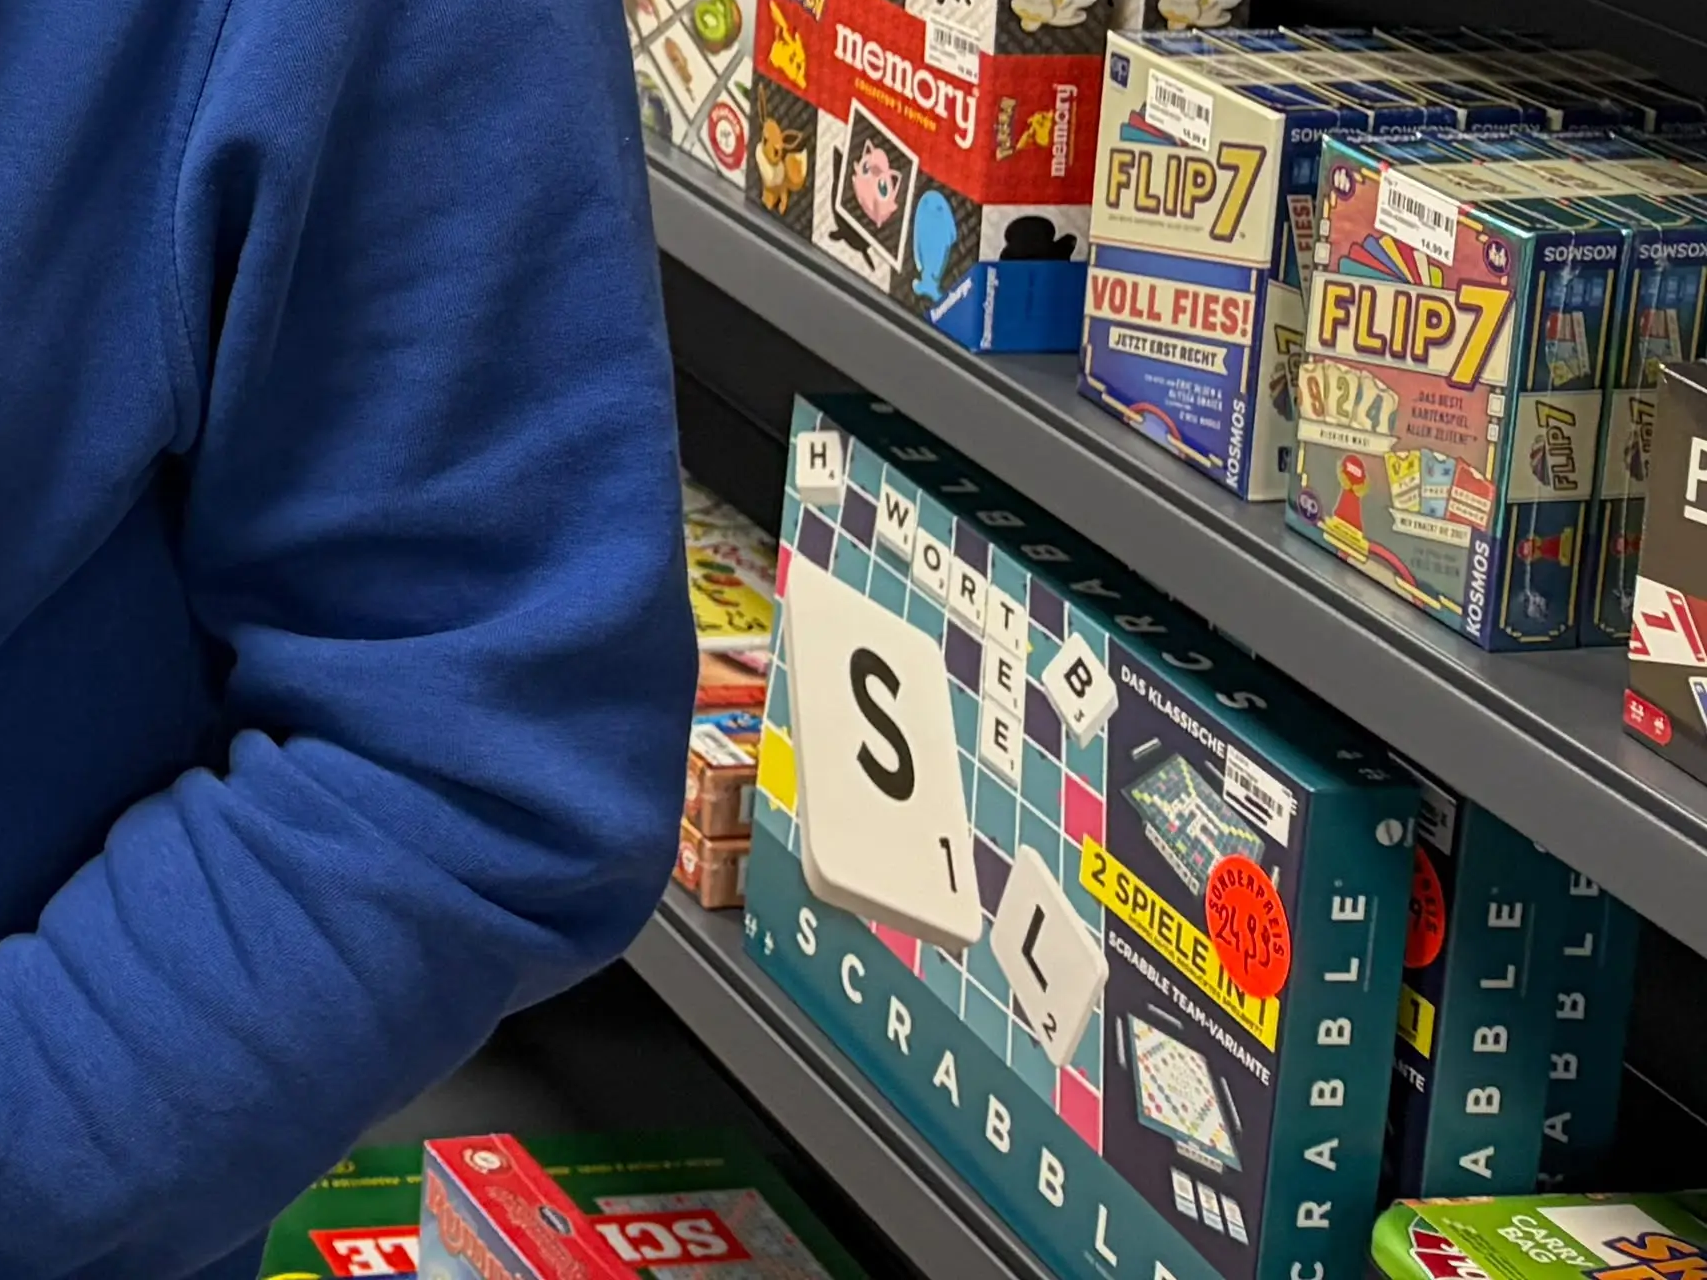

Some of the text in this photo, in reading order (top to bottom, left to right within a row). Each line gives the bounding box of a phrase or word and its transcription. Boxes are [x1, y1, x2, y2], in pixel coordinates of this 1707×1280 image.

[833, 22, 980, 150] memory
[1051, 83, 1079, 178] memory
[1543, 245, 1618, 263] KOSMOS
[1090, 274, 1252, 338] VOLL FIES!
[1113, 331, 1218, 368] JETZT ERST RECHT
[809, 441, 827, 470] H
[1225, 399, 1246, 489] KOSMOS
[1465, 540, 1491, 638] KOSMOS
[1063, 657, 1094, 700] B
[1120, 664, 1227, 760] DAS KLASSISCHE
[849, 647, 916, 801] S
[1021, 903, 1048, 993] L
[1090, 852, 1108, 888] 2
[1114, 872, 1210, 975] SPIELE
[1108, 930, 1171, 997] SCRABBLE
[1171, 983, 1272, 1088] TEAM-VARIANTE
[1496, 1227, 1559, 1265] BAG
[1510, 1214, 1597, 1269] CARRY
